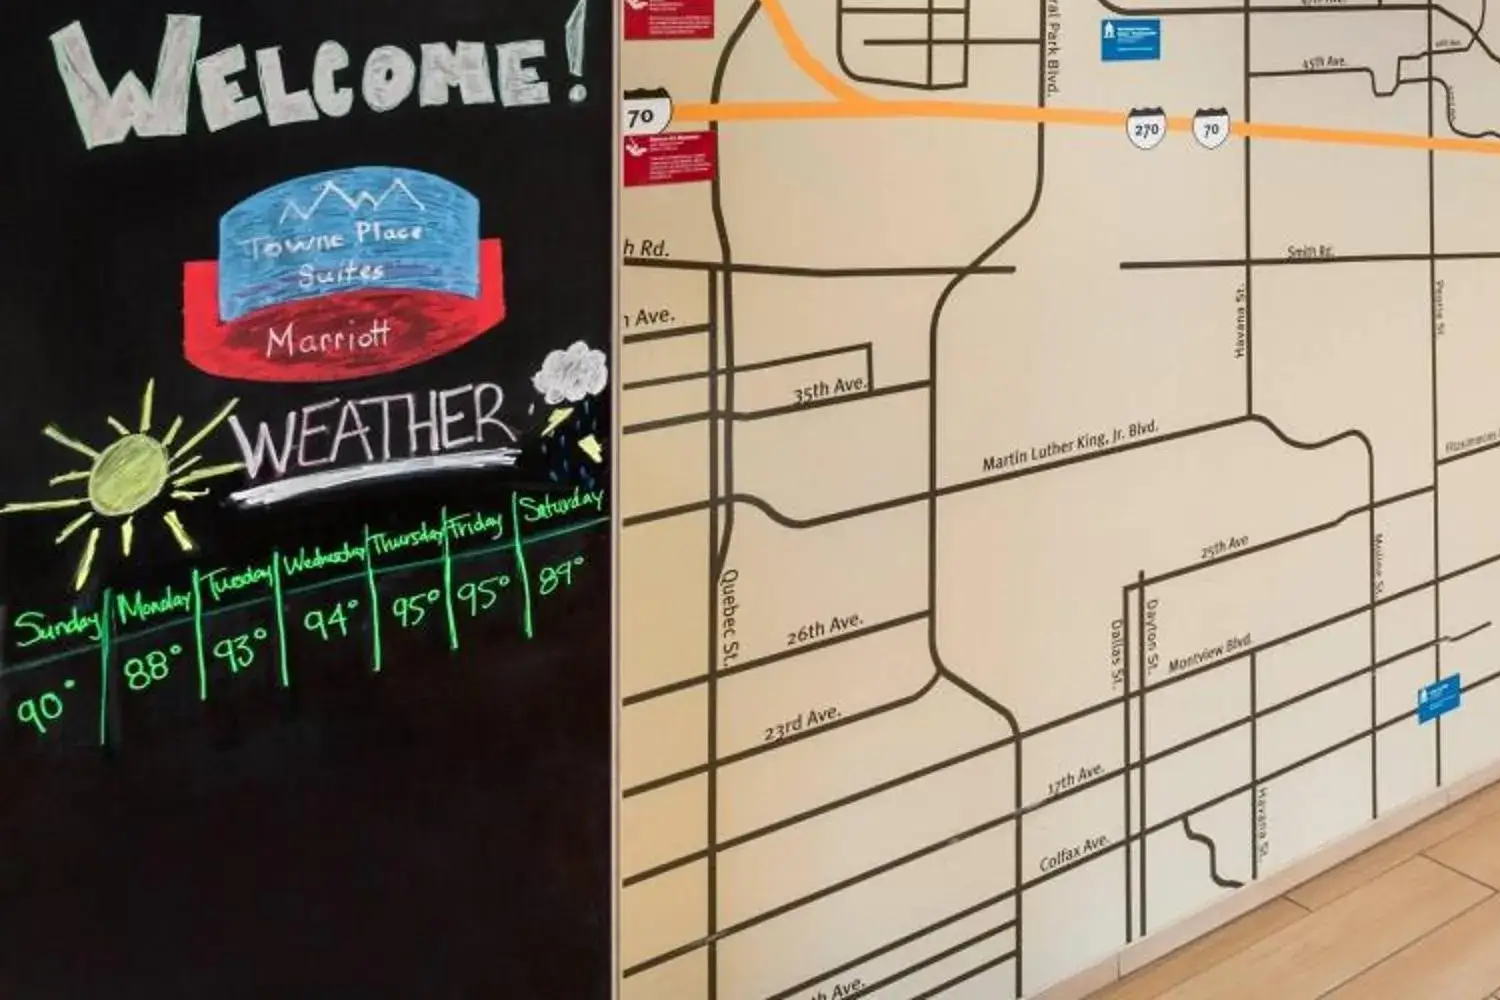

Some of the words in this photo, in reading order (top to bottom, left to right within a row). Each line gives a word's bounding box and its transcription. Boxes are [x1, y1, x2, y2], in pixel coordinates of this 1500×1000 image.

[1047, 21, 1061, 56] Park
[1327, 54, 1346, 67] Ave.
[1047, 59, 1061, 99] Blvd.
[628, 109, 654, 128] 70
[1135, 122, 1159, 139] 270
[1203, 123, 1219, 138] 70
[240, 229, 345, 261] Towne
[354, 219, 425, 246] Place
[641, 239, 670, 257] Rd.
[297, 259, 385, 288] Suites
[1234, 283, 1245, 302] St.
[636, 309, 675, 329] Ave.
[1233, 304, 1245, 359] Havana
[265, 319, 390, 359] Marriott
[794, 381, 829, 404] 35th
[833, 375, 870, 395] Ave.
[228, 383, 518, 480] WEATHER
[982, 449, 1028, 472] Martin
[1031, 440, 1072, 462] Luther
[1076, 431, 1110, 452] King,
[1113, 426, 1126, 443] Jr.
[1128, 419, 1160, 439] Blvd.
[14, 608, 103, 648] Sunday
[116, 590, 193, 625] Monday
[369, 520, 444, 556] Thursday
[446, 512, 502, 541] Friday
[519, 486, 604, 522] Saturday
[1201, 541, 1227, 559] 25th
[722, 569, 738, 638] Quebec
[787, 624, 824, 646] 26th
[827, 613, 865, 638] Ave.
[1146, 600, 1159, 650] Dayton
[722, 641, 738, 669] St.
[1112, 619, 1123, 667] Dallas
[1168, 643, 1224, 674] Montview
[1226, 633, 1253, 653] Blvd.
[1112, 671, 1123, 691] St.
[1147, 654, 1159, 677] St.
[764, 714, 803, 742] 23rd
[804, 704, 842, 728] Ave.
[1047, 773, 1071, 797] 17th
[1074, 761, 1106, 785] Ave.
[1257, 787, 1269, 839] Havana
[1040, 845, 1081, 873] Colfax
[1083, 833, 1111, 857] Ave.
[1257, 842, 1269, 864] St.
